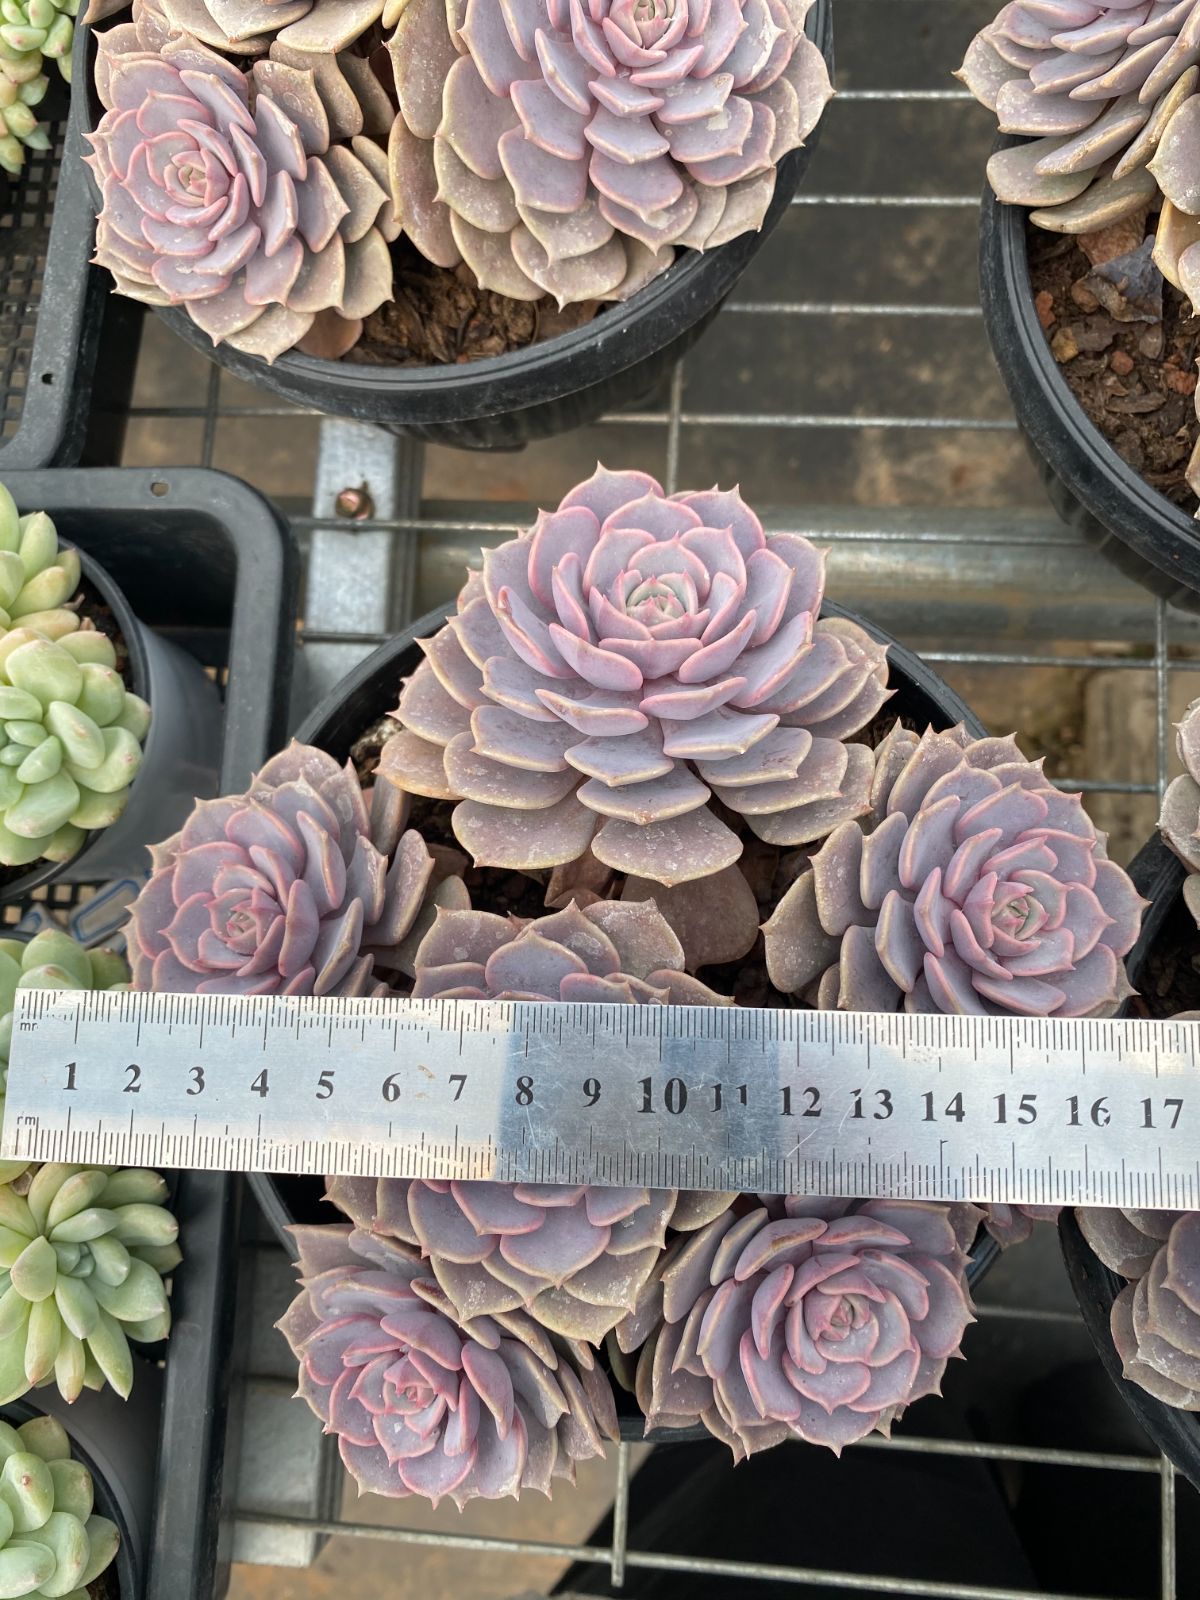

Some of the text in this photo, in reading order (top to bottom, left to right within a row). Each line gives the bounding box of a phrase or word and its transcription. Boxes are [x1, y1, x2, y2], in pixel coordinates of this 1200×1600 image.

[62, 1062, 1184, 1129] 1 2 3 4 5 6 7 8 9 10 11 12 13 14 15 16 17
